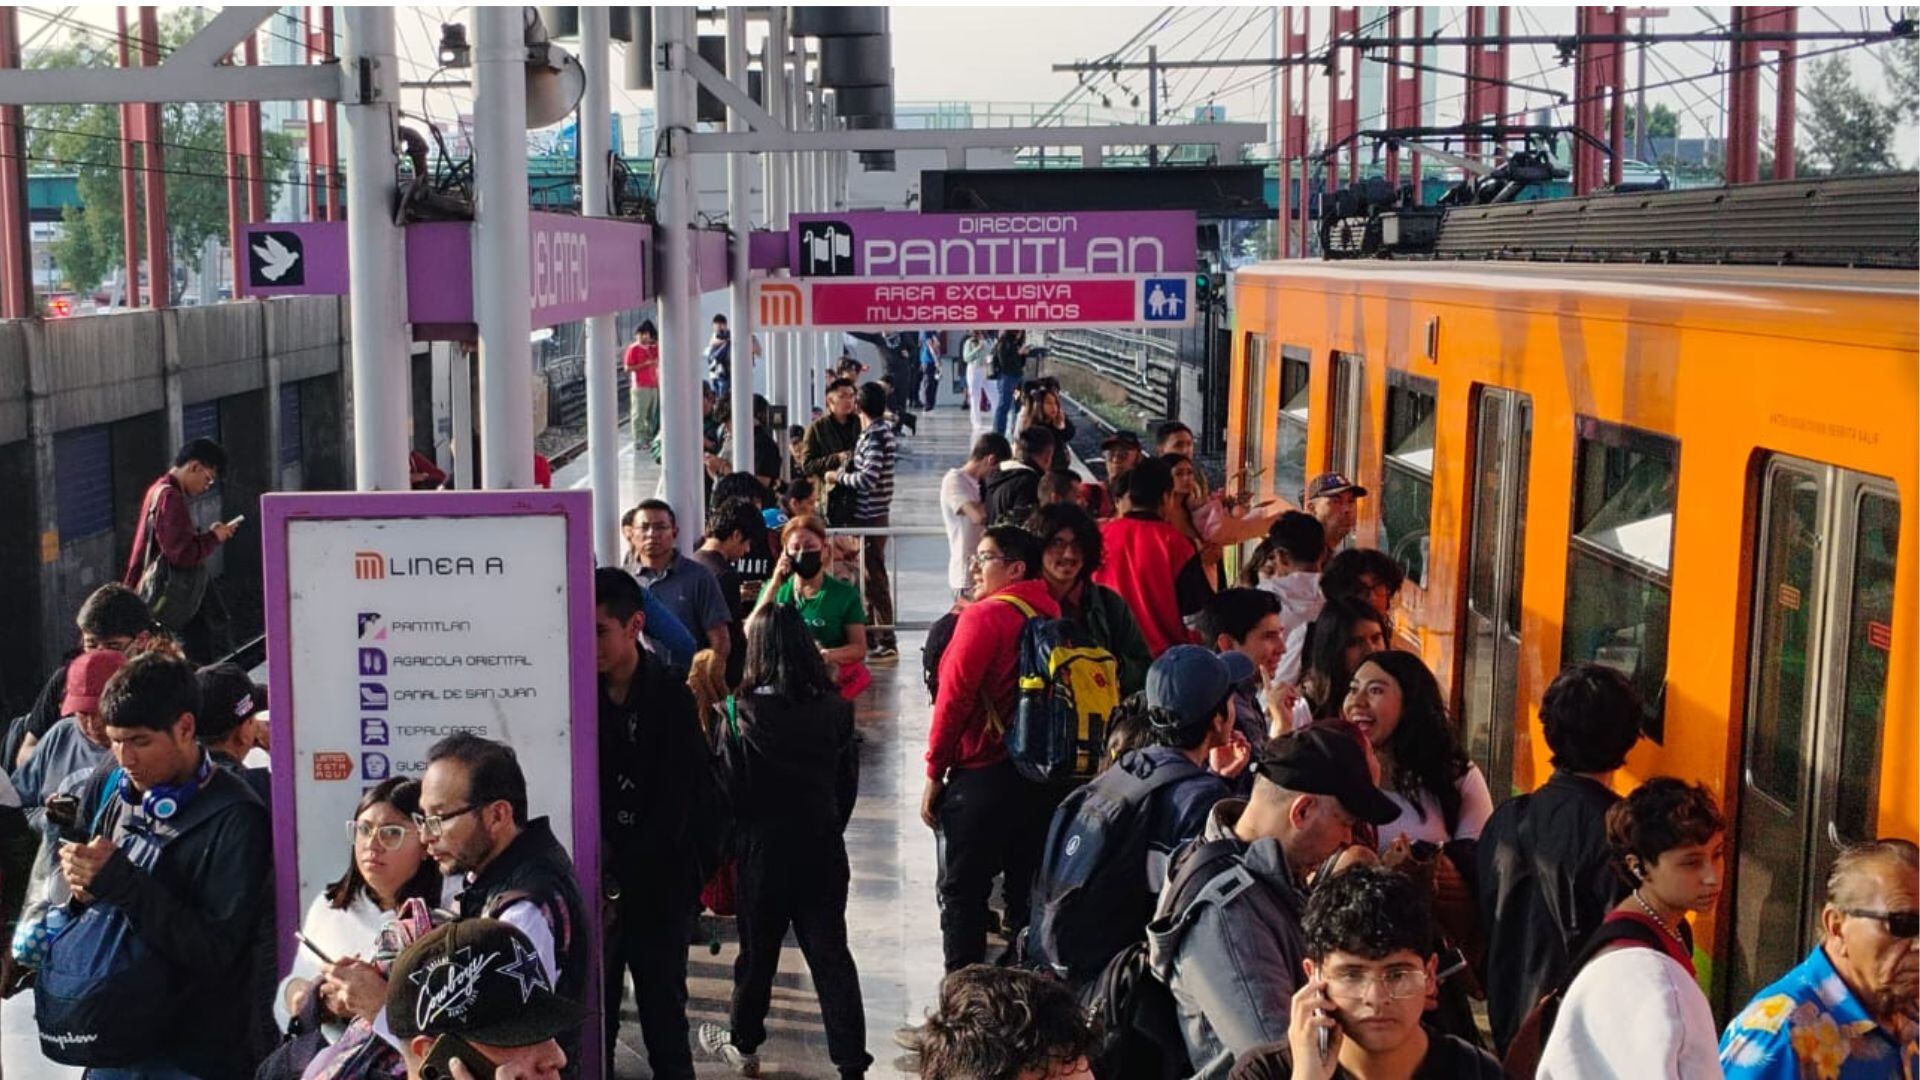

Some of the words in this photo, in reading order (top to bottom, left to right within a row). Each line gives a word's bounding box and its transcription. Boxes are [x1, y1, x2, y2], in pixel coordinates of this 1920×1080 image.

[959, 216, 1077, 233] DIRECCION
[864, 236, 1164, 275] PANTITLAN
[875, 284, 935, 301] AREA
[946, 284, 1072, 300] EXCLUSIVA
[866, 305, 977, 321] MUJERES
[988, 305, 1000, 320] Y
[1014, 301, 1080, 320] NIÑOS
[390, 557, 474, 576] LINEA
[486, 557, 503, 575] A
[392, 621, 471, 632] PANTITLAN
[393, 656, 462, 666] AGRICOLA
[466, 655, 532, 666] ORIENTAL
[394, 689, 440, 700] CANAL
[443, 689, 463, 699] DE
[466, 688, 495, 699] SAN
[499, 687, 537, 698] JUAN
[416, 951, 501, 1031] Cowboys
